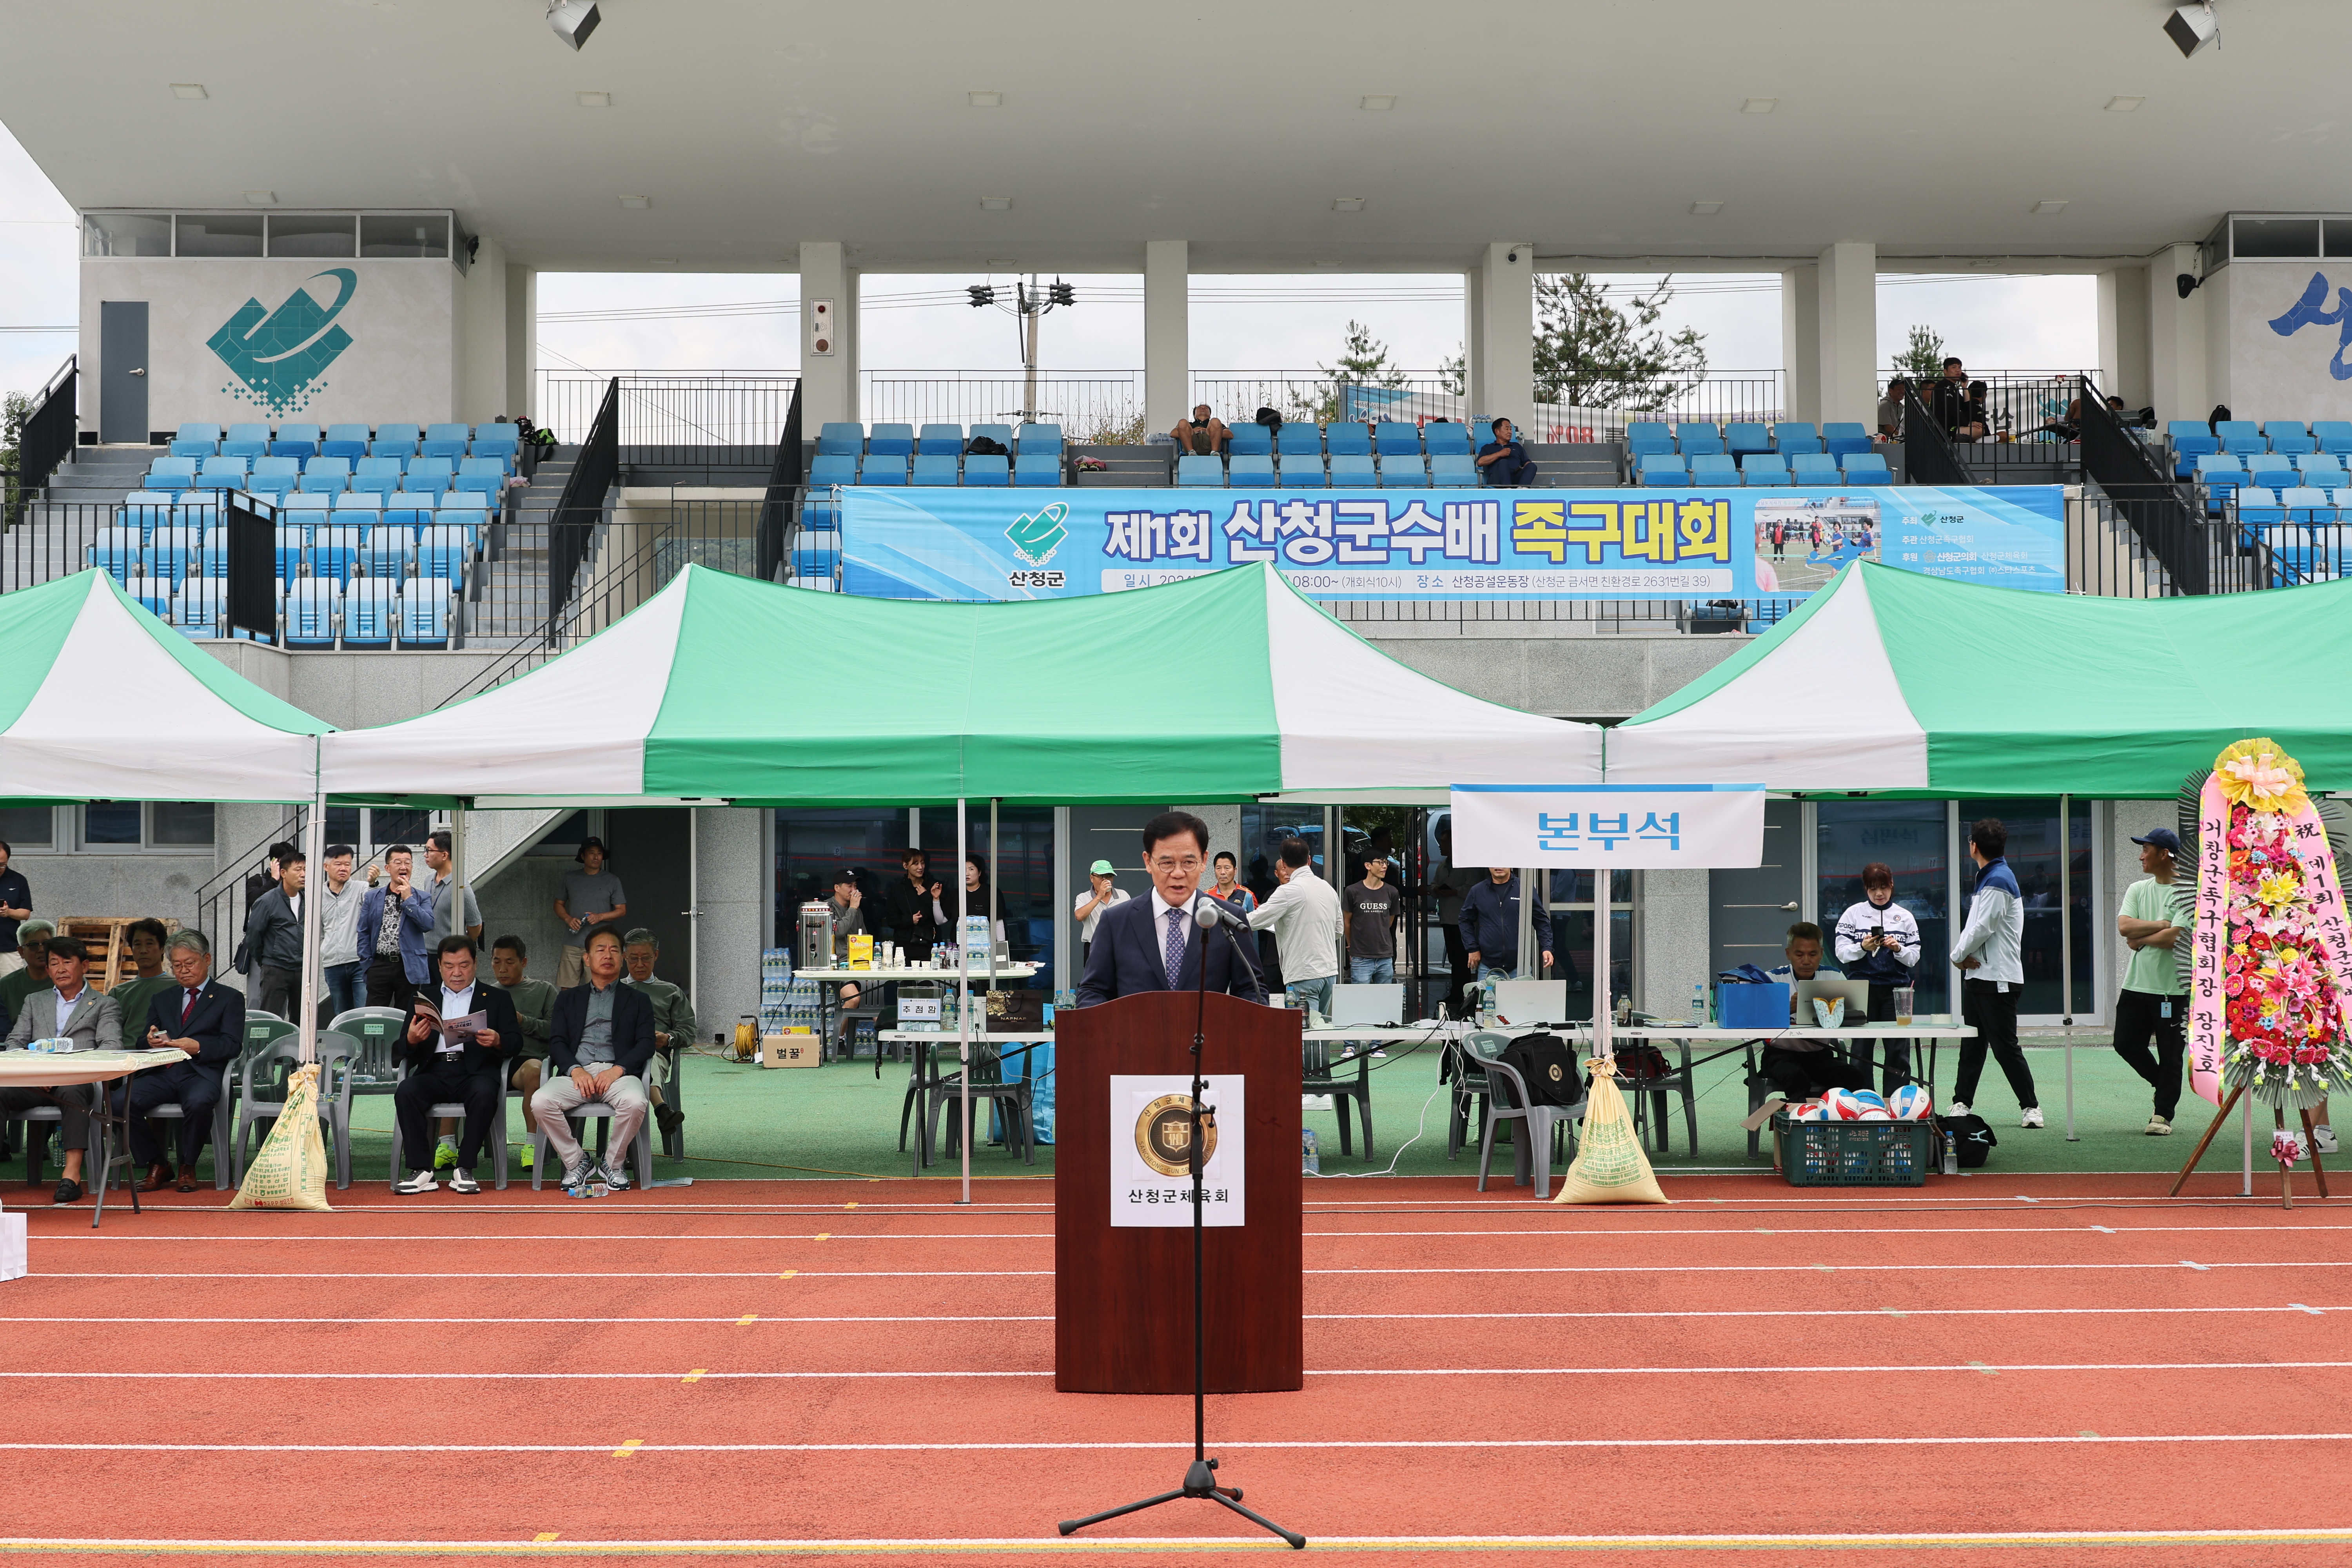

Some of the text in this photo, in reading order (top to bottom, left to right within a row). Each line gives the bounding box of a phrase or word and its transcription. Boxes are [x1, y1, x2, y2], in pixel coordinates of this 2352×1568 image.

[1902, 517, 1917, 525] 주최
[1103, 498, 1731, 565] 제1회 산청군수배 족구대회
[1902, 535, 1974, 544] 주관 산청군족구협회
[1902, 551, 2028, 562] 후원 산청군의회 산청군체육회
[1923, 566, 1985, 575] 경상남도족구협회
[1009, 572, 1064, 587] 산청군
[1341, 576, 1402, 589] (개회식10시)
[1452, 575, 1529, 588] 산청공설운동장
[1532, 575, 1566, 588] (산청군
[1568, 575, 1599, 588] 금서면
[1601, 575, 1641, 588] 친환경로
[1643, 575, 1690, 587] 2631번길
[1692, 575, 1710, 587] 39)
[1537, 812, 1680, 851] 본부석
[2294, 822, 2321, 839] 祝
[2305, 856, 2334, 906] 제1회
[902, 1005, 936, 1014] 추첨함
[2194, 1011, 2218, 1074] 장진호
[777, 1048, 800, 1059] 벌꿀
[1138, 1141, 1179, 1174] SANCHEONG-GUN
[1128, 1189, 1229, 1204] 산청군체육회
